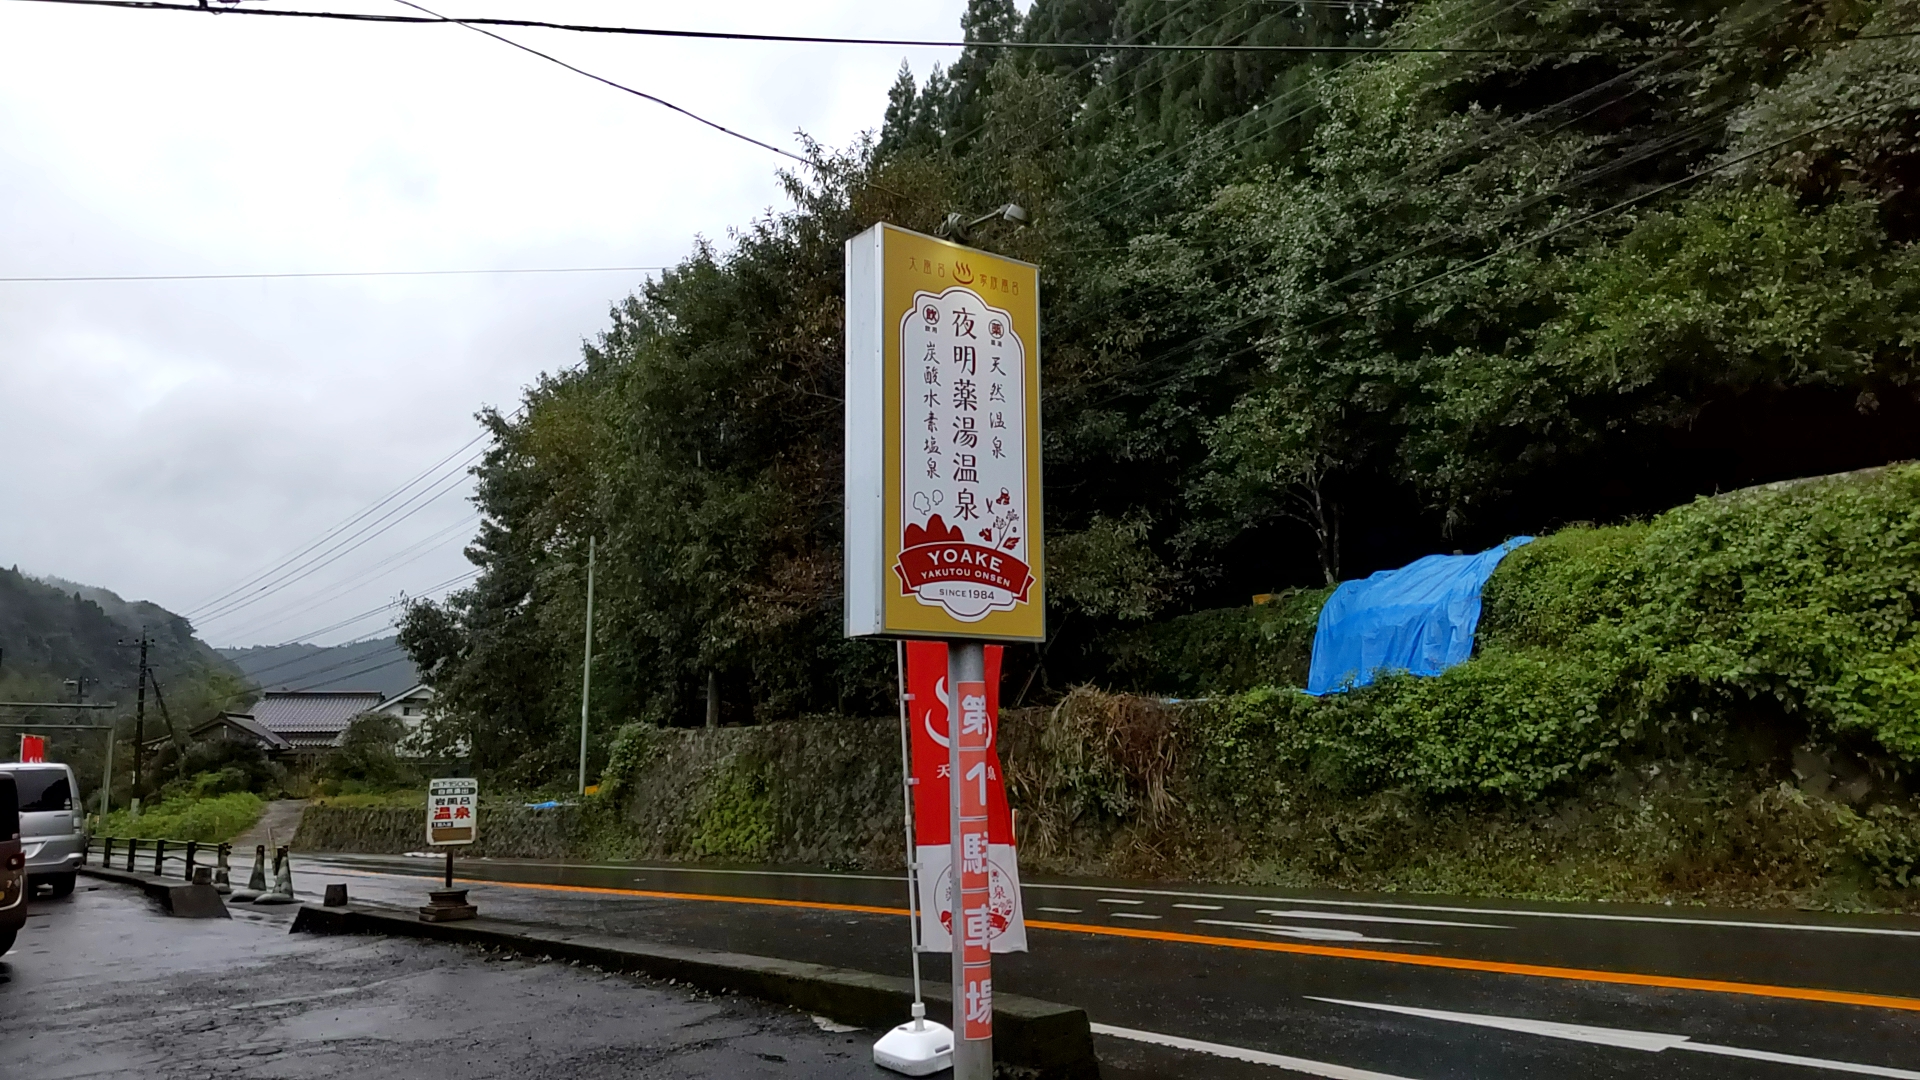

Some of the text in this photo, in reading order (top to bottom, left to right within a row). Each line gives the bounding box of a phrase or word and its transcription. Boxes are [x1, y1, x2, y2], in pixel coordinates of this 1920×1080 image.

[923, 341, 942, 479] 炭酸水素塩泉
[952, 307, 980, 521] 夜明薬湯温泉
[989, 356, 1007, 459] 天然温泉
[927, 549, 1003, 573] YOAKE
[920, 567, 1010, 587] YAKUTOU ONSEN
[433, 806, 471, 820] 温泉
[435, 796, 471, 806] 岩風呂
